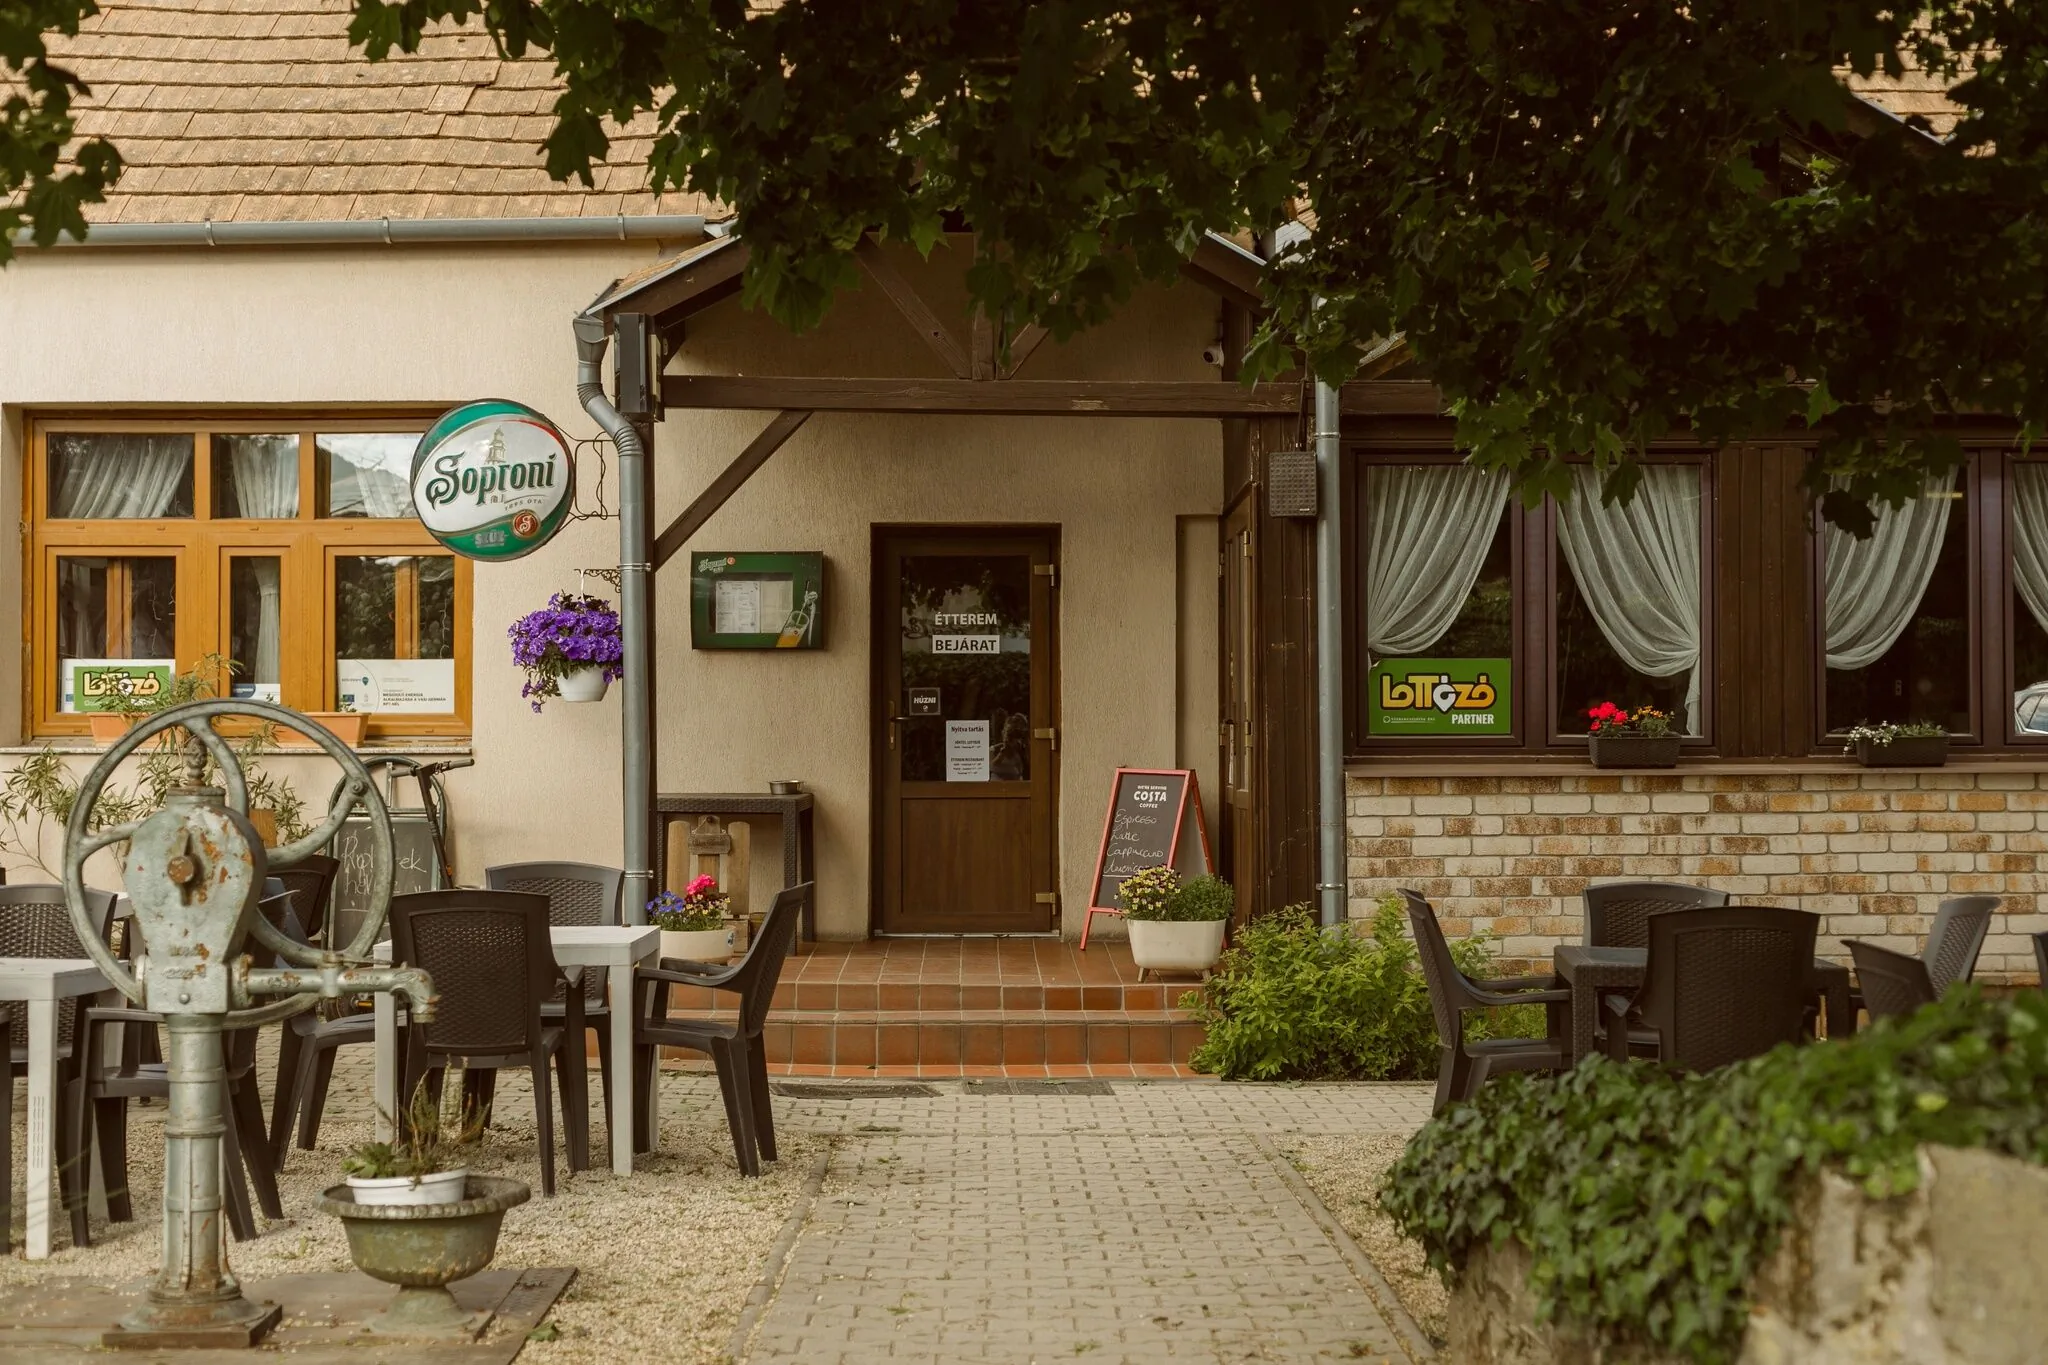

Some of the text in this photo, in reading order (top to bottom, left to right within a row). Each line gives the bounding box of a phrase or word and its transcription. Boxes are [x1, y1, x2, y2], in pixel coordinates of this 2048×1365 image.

[425, 451, 557, 513] Soproni
[934, 611, 998, 626] ÉTTEREM
[935, 637, 997, 652] BEJÁRAT
[913, 694, 936, 704] HÚZNI
[1451, 713, 1494, 725] PARTNER
[1133, 790, 1167, 802] COSTA
[1115, 809, 1157, 829] Espresso
